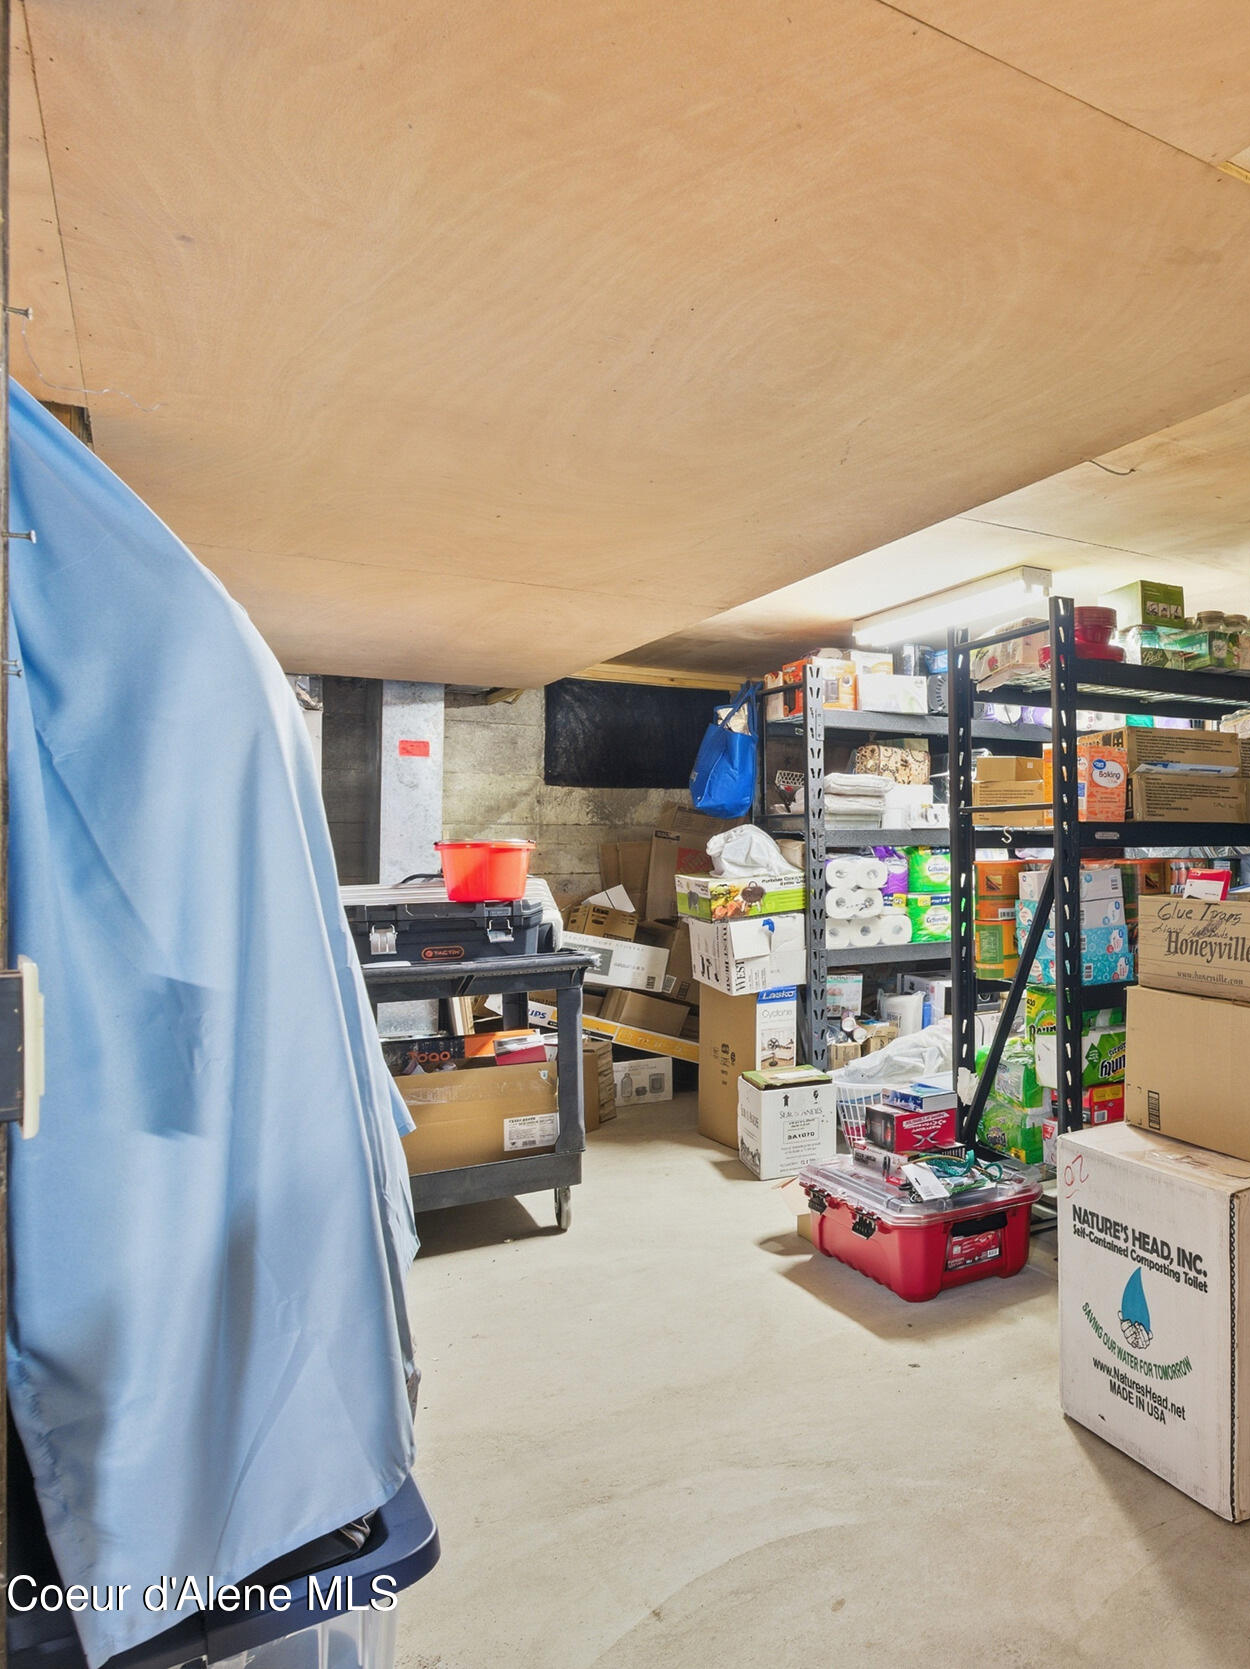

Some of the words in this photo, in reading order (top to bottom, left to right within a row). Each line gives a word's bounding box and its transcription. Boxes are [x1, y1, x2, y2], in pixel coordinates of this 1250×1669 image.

[1098, 770, 1122, 780] Baking
[1157, 902, 1194, 921] Glue
[1199, 902, 1243, 926] Traps
[762, 990, 795, 1000] Lasko
[1072, 1204, 1129, 1243] NATURE'S
[1131, 1228, 1174, 1266] HEAD,
[1176, 1246, 1208, 1277] INC.
[1073, 1224, 1129, 1258] Self-Contained
[1130, 1249, 1181, 1283] Composting
[1183, 1271, 1208, 1293] Toilet
[1082, 1302, 1104, 1339] SAVING
[1102, 1333, 1117, 1355] OUR
[1116, 1346, 1140, 1373] WATER
[1139, 1359, 1154, 1378] FOR
[1153, 1355, 1193, 1381] TOMORROW
[1092, 1357, 1186, 1421] www.NaturesHead.net
[1109, 1379, 1135, 1407] MADE
[1135, 1394, 1146, 1412] IN
[1147, 1401, 1167, 1424] USA
